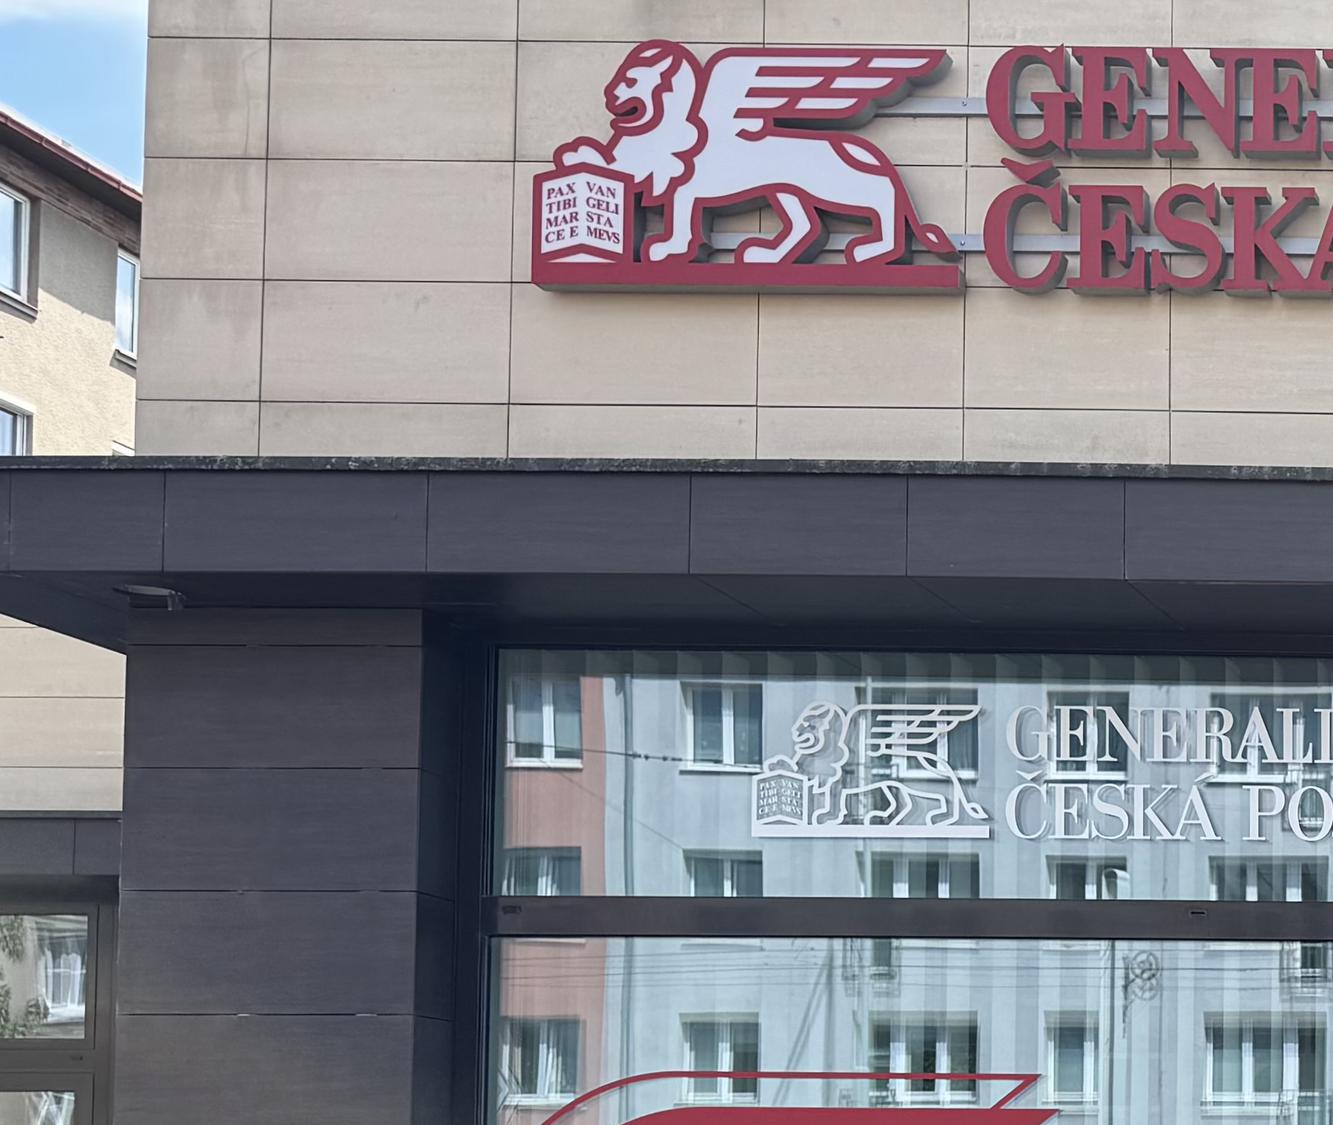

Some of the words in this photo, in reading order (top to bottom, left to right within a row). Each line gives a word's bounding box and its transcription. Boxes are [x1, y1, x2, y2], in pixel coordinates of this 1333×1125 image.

[547, 182, 576, 200] PAX
[586, 181, 617, 199] VAN
[546, 197, 577, 214] TIBI
[586, 196, 620, 215] GELI
[545, 211, 579, 230] MAR
[586, 211, 614, 228] STA
[545, 229, 565, 243] CE
[569, 226, 579, 238] E
[1004, 769, 1223, 842] ČESKÁ
